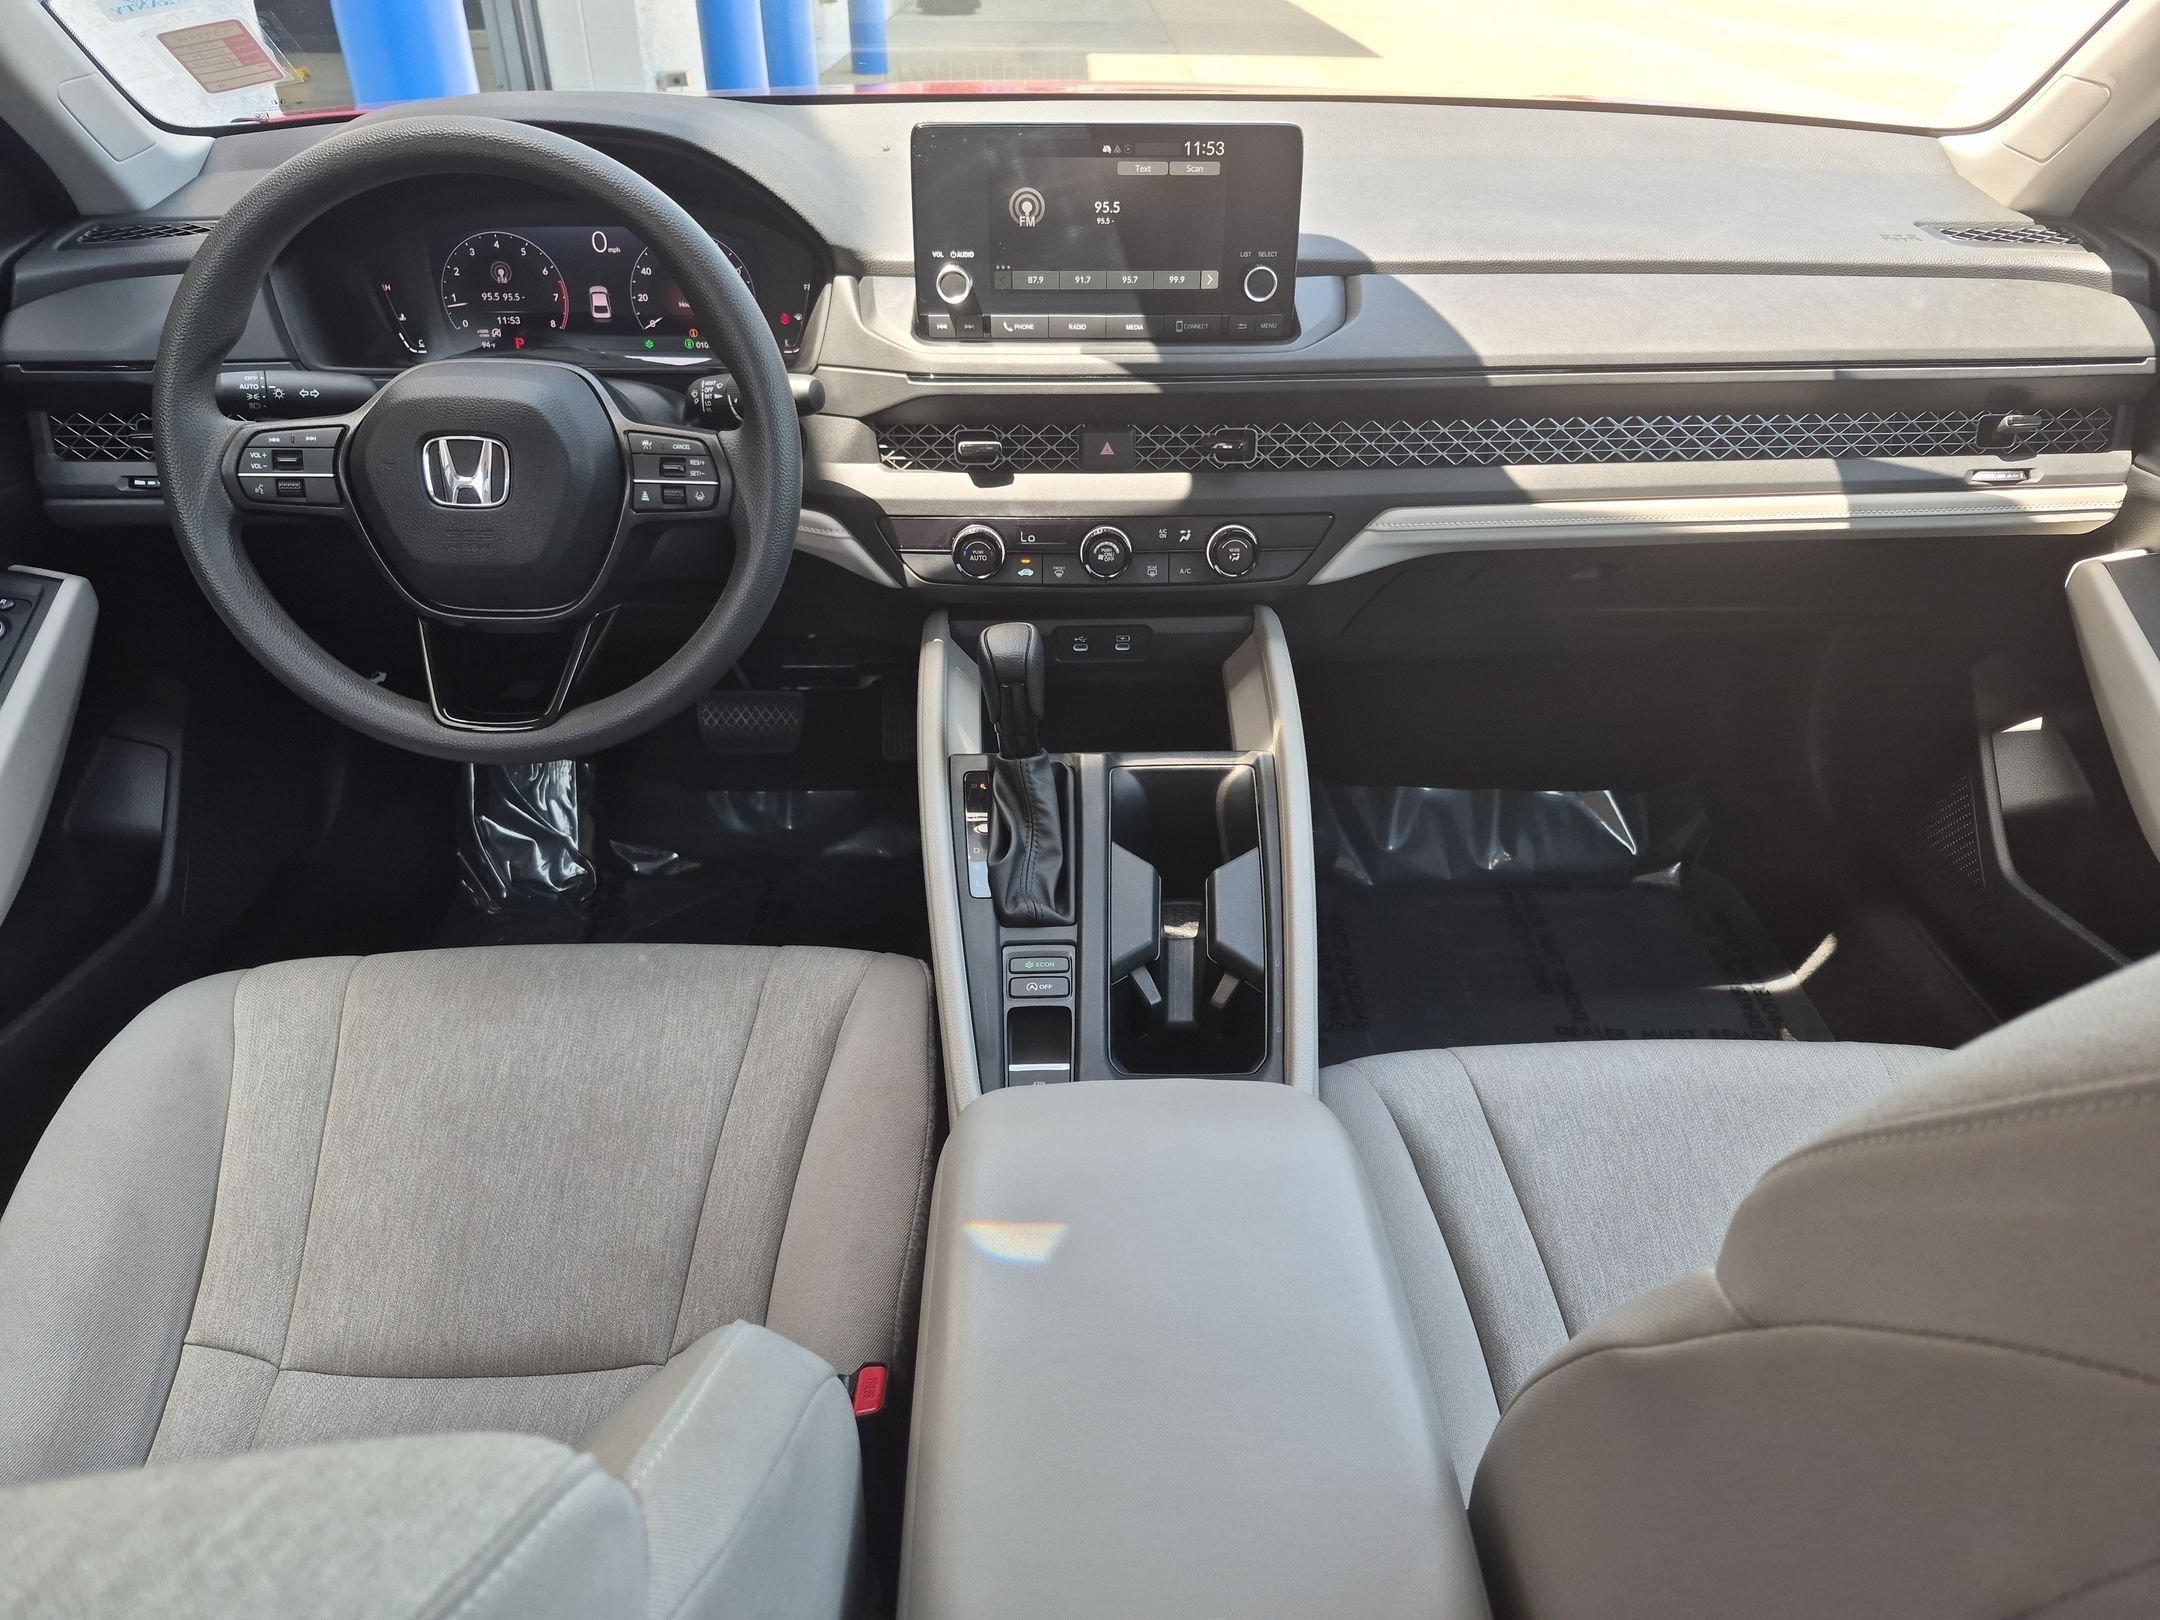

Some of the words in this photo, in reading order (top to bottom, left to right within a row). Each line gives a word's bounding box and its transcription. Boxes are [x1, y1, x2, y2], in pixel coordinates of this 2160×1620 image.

[1184, 141, 1225, 156] 11:53
[1135, 165, 1152, 173] Text
[1186, 165, 1204, 173] Scan
[1094, 201, 1121, 214] 95.5
[1019, 216, 1036, 228] FM
[494, 241, 500, 249] 4
[592, 231, 607, 253] 0
[469, 247, 475, 256] 3
[521, 248, 527, 256] 5
[453, 267, 460, 276] 2
[542, 267, 549, 275] 6
[641, 267, 652, 276] 40
[1027, 276, 1044, 284] 87.9
[1074, 276, 1091, 284] 91.7
[1122, 276, 1138, 284] 95.7
[1169, 276, 1185, 284] 99.9
[451, 294, 457, 302] 1
[481, 293, 500, 302] 95.5
[502, 293, 520, 302] 95.5
[553, 294, 559, 302] 7
[638, 294, 649, 302] 20
[462, 320, 469, 328] 0
[497, 316, 521, 325] 11:53
[550, 320, 556, 328] 8
[515, 337, 525, 350] P
[1021, 531, 1036, 543] Lo
